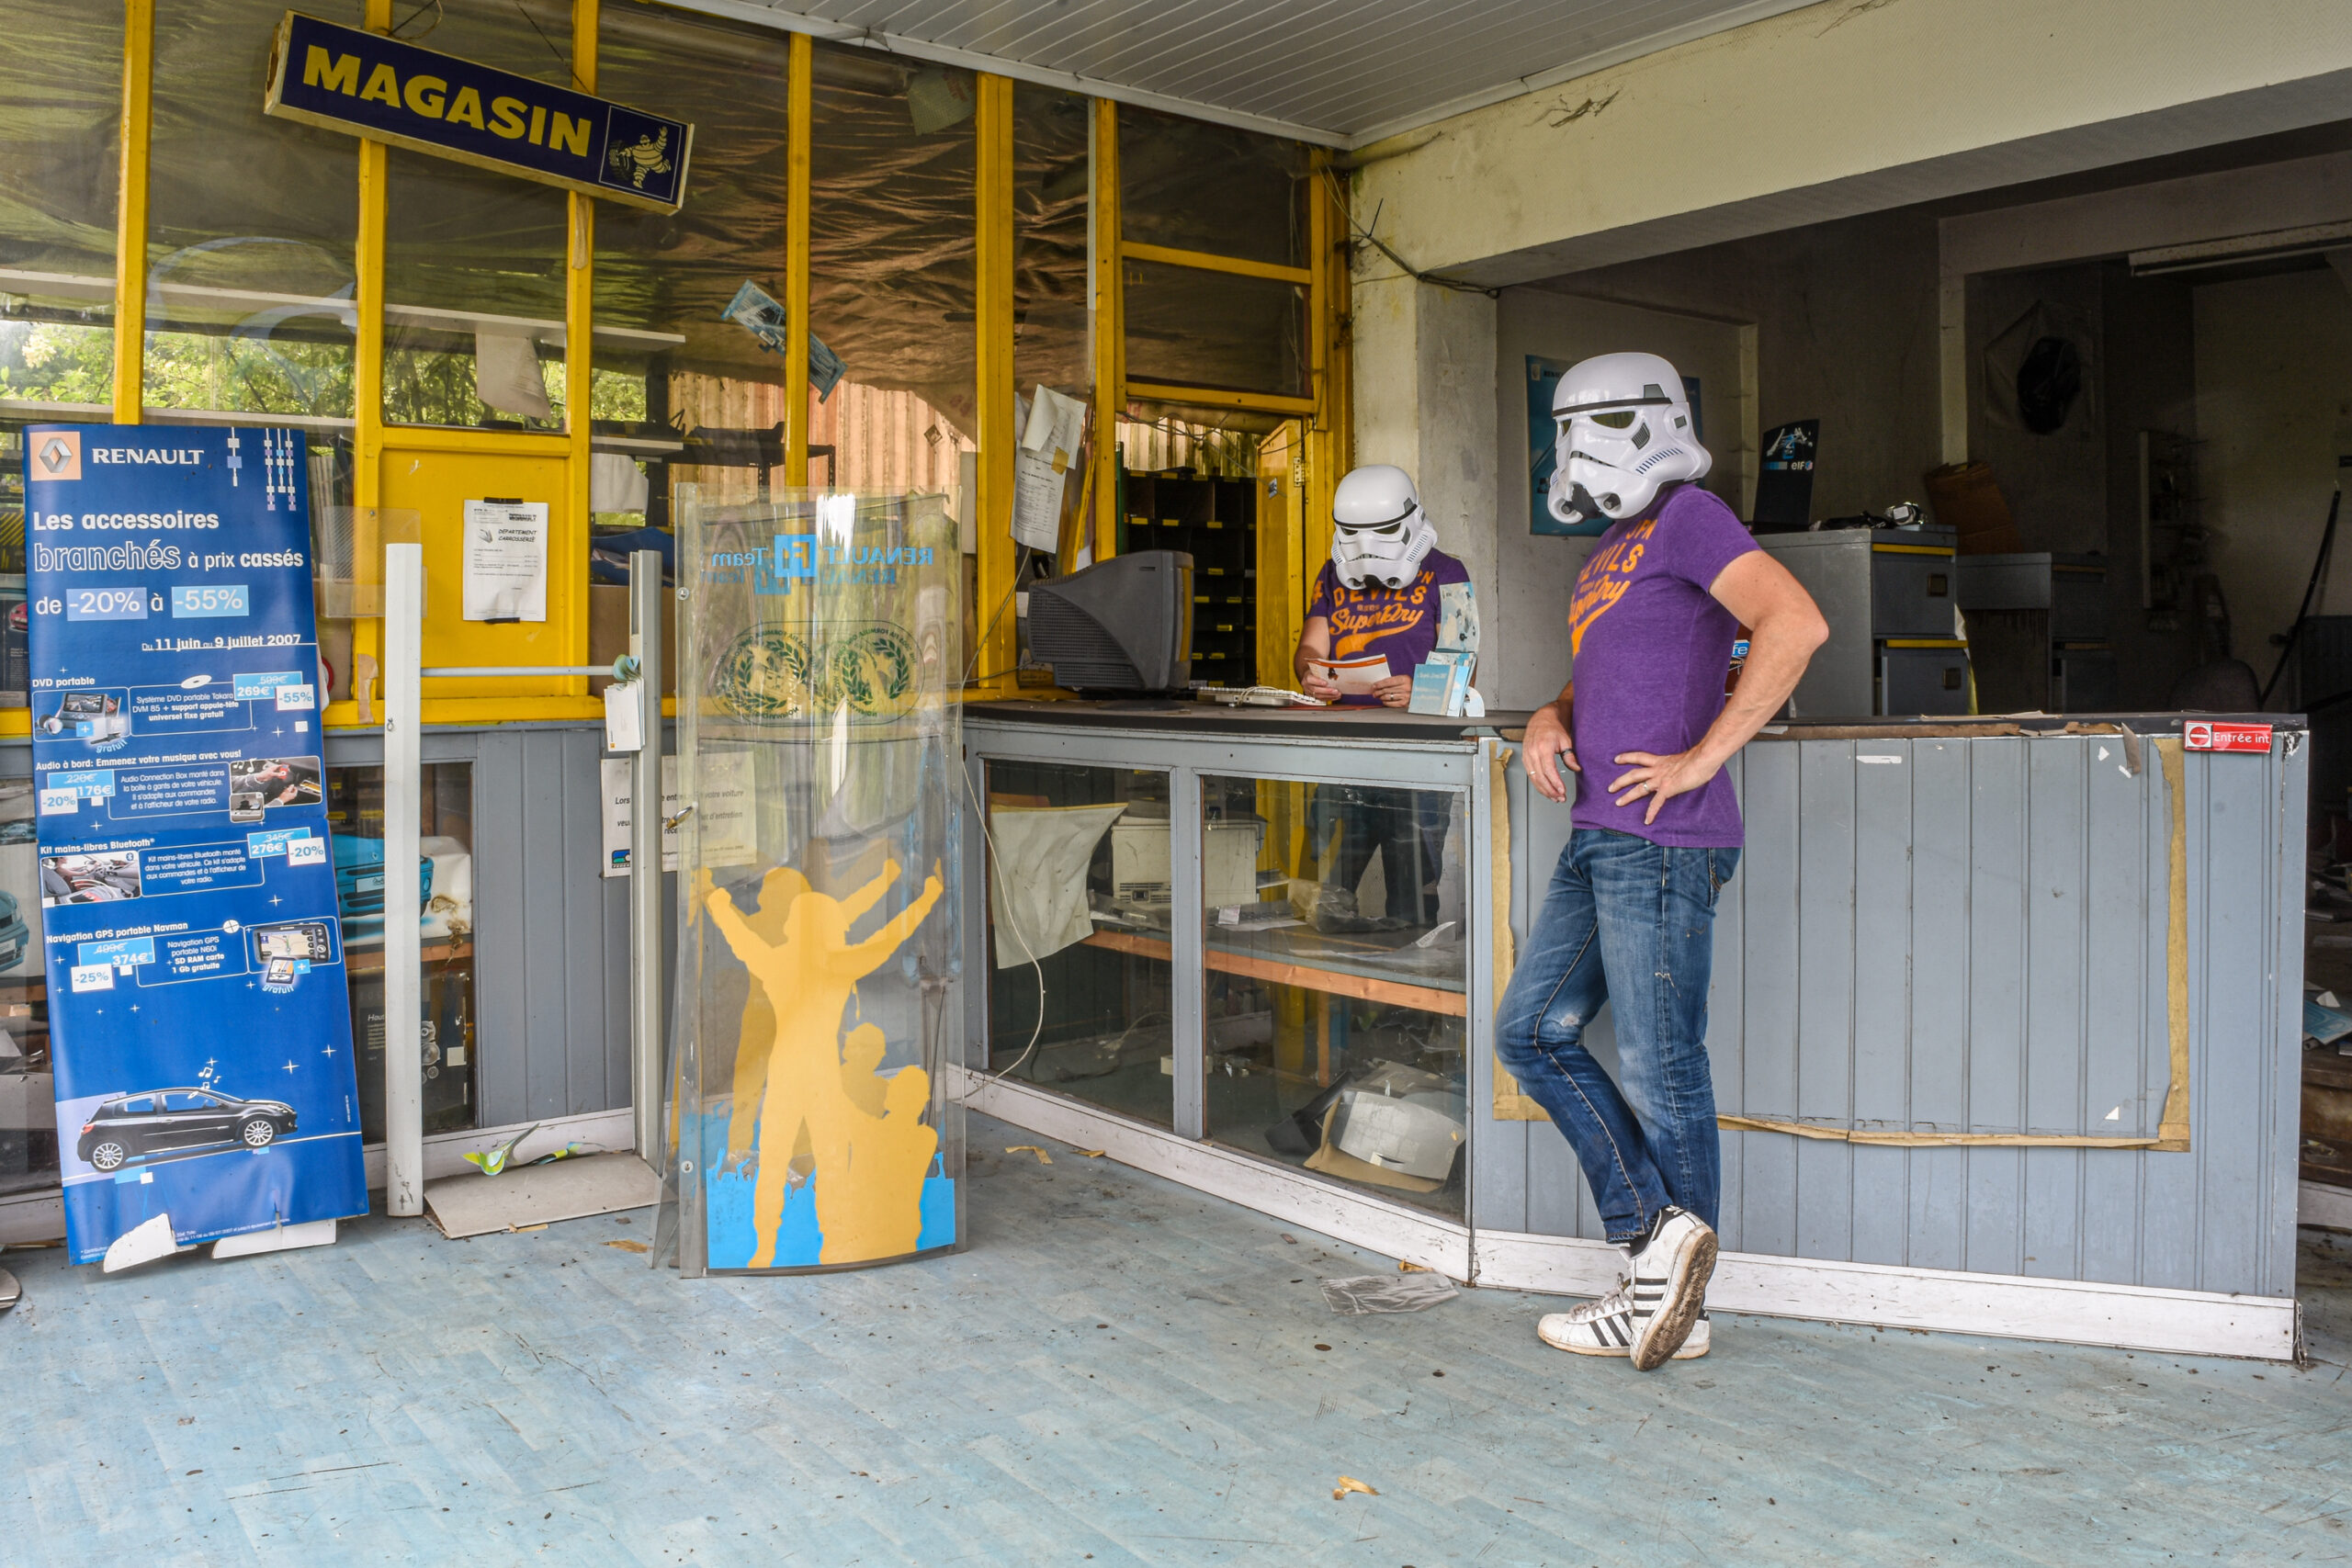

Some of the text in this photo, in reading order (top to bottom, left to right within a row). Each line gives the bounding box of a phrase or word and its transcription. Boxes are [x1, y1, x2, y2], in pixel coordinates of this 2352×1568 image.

[303, 44, 591, 156] MAGASIN
[92, 448, 204, 465] RENAULT
[1792, 461, 1805, 470] elf
[33, 510, 220, 531] Les accessoires
[34, 539, 304, 571] branchés à prix cassés
[35, 589, 243, 615] de -20% à -55%
[141, 642, 153, 651] Du
[154, 638, 172, 649] 11
[175, 637, 201, 652] juin
[214, 637, 224, 648] 9
[227, 635, 264, 650] juillet
[267, 634, 301, 646] 2007
[32, 676, 96, 689] DVD portable
[183, 693, 210, 702] portable
[278, 692, 312, 704] -55%
[171, 703, 198, 713] support
[149, 710, 224, 722] universel fixe gratuit
[2213, 732, 2253, 743] Entrée
[96, 739, 128, 754] gratuit
[36, 761, 61, 772] Audio
[62, 761, 69, 769] à
[96, 757, 136, 768] Emmenez
[139, 755, 160, 764] votre
[162, 752, 197, 764] musique
[198, 751, 218, 760] avec
[220, 750, 242, 760] vous!
[120, 775, 139, 784] Audio
[141, 773, 174, 782] Connection
[175, 772, 188, 780] Box
[189, 770, 208, 779] monté
[77, 784, 112, 796] 176€
[181, 780, 196, 788] votre
[42, 795, 76, 807] -20%
[40, 846, 52, 855] Kit
[54, 842, 107, 854] mains-libres
[252, 842, 283, 854] 276€
[290, 846, 323, 858] -20%
[157, 852, 193, 863] mains-libres
[195, 850, 221, 859] Bluetooth
[144, 863, 159, 872] dans
[161, 862, 175, 870] votre
[159, 870, 196, 879] commandes
[181, 877, 196, 886] votre
[47, 922, 188, 944] Navigation GPS portable Navman
[167, 936, 220, 949] Navigation GPS
[172, 947, 198, 958] portable
[206, 953, 224, 963] carte
[192, 963, 220, 974] gratuite
[74, 972, 108, 985] -25%
[262, 985, 294, 994] gratuit
